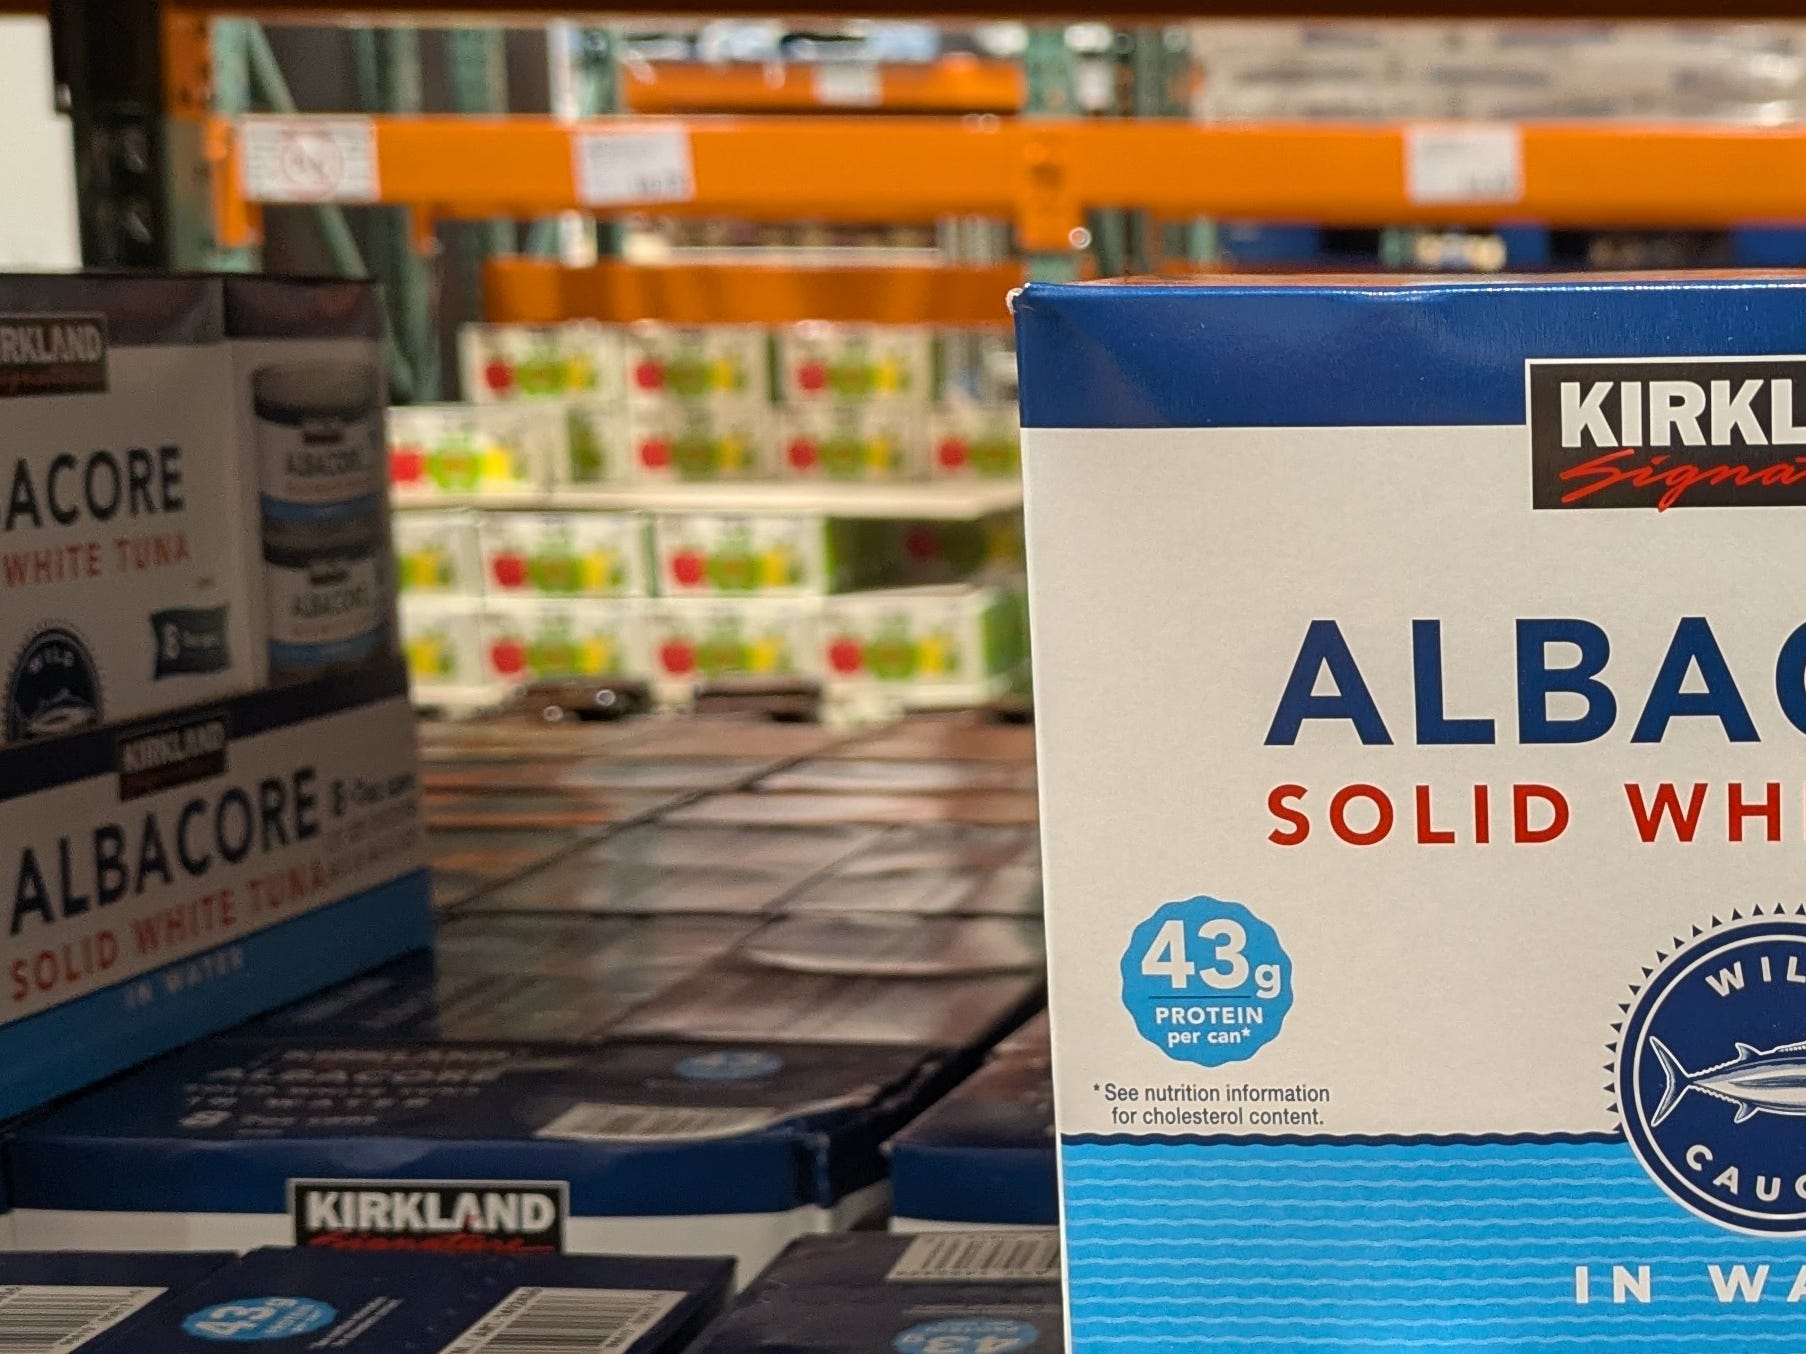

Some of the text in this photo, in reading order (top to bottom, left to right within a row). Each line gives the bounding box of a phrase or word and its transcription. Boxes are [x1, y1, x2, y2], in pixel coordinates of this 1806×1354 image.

[1267, 784, 1570, 846] SOLID
[10, 766, 321, 938] ALBACORE
[11, 931, 118, 1000] SOLID
[1141, 918, 1281, 999] 43g
[1155, 1006, 1263, 1024] PROTEIN
[1168, 1031, 1200, 1047] per
[1145, 1083, 1220, 1101] nutrition
[1226, 1083, 1330, 1102] information
[1112, 1107, 1324, 1126] for cholesterol content.
[307, 1191, 555, 1232] KIRKLAND
[1575, 1265, 1651, 1303] IN
